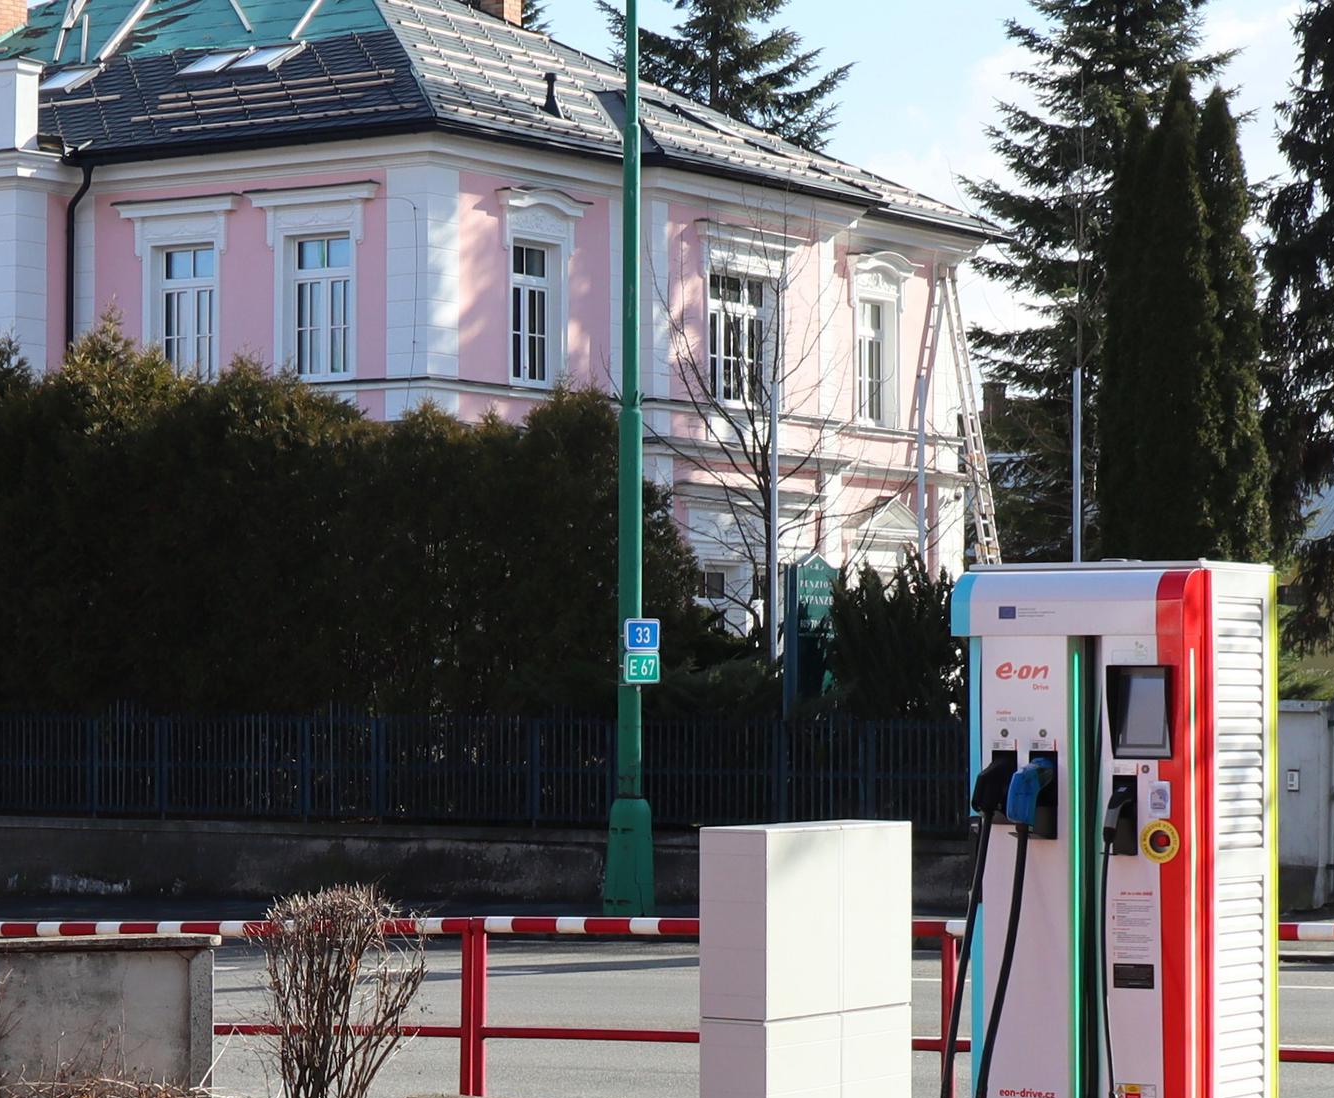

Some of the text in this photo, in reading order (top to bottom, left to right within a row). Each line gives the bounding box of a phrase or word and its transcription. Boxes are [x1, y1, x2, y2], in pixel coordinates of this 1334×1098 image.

[635, 627, 651, 643] 33
[630, 659, 655, 676] E 67
